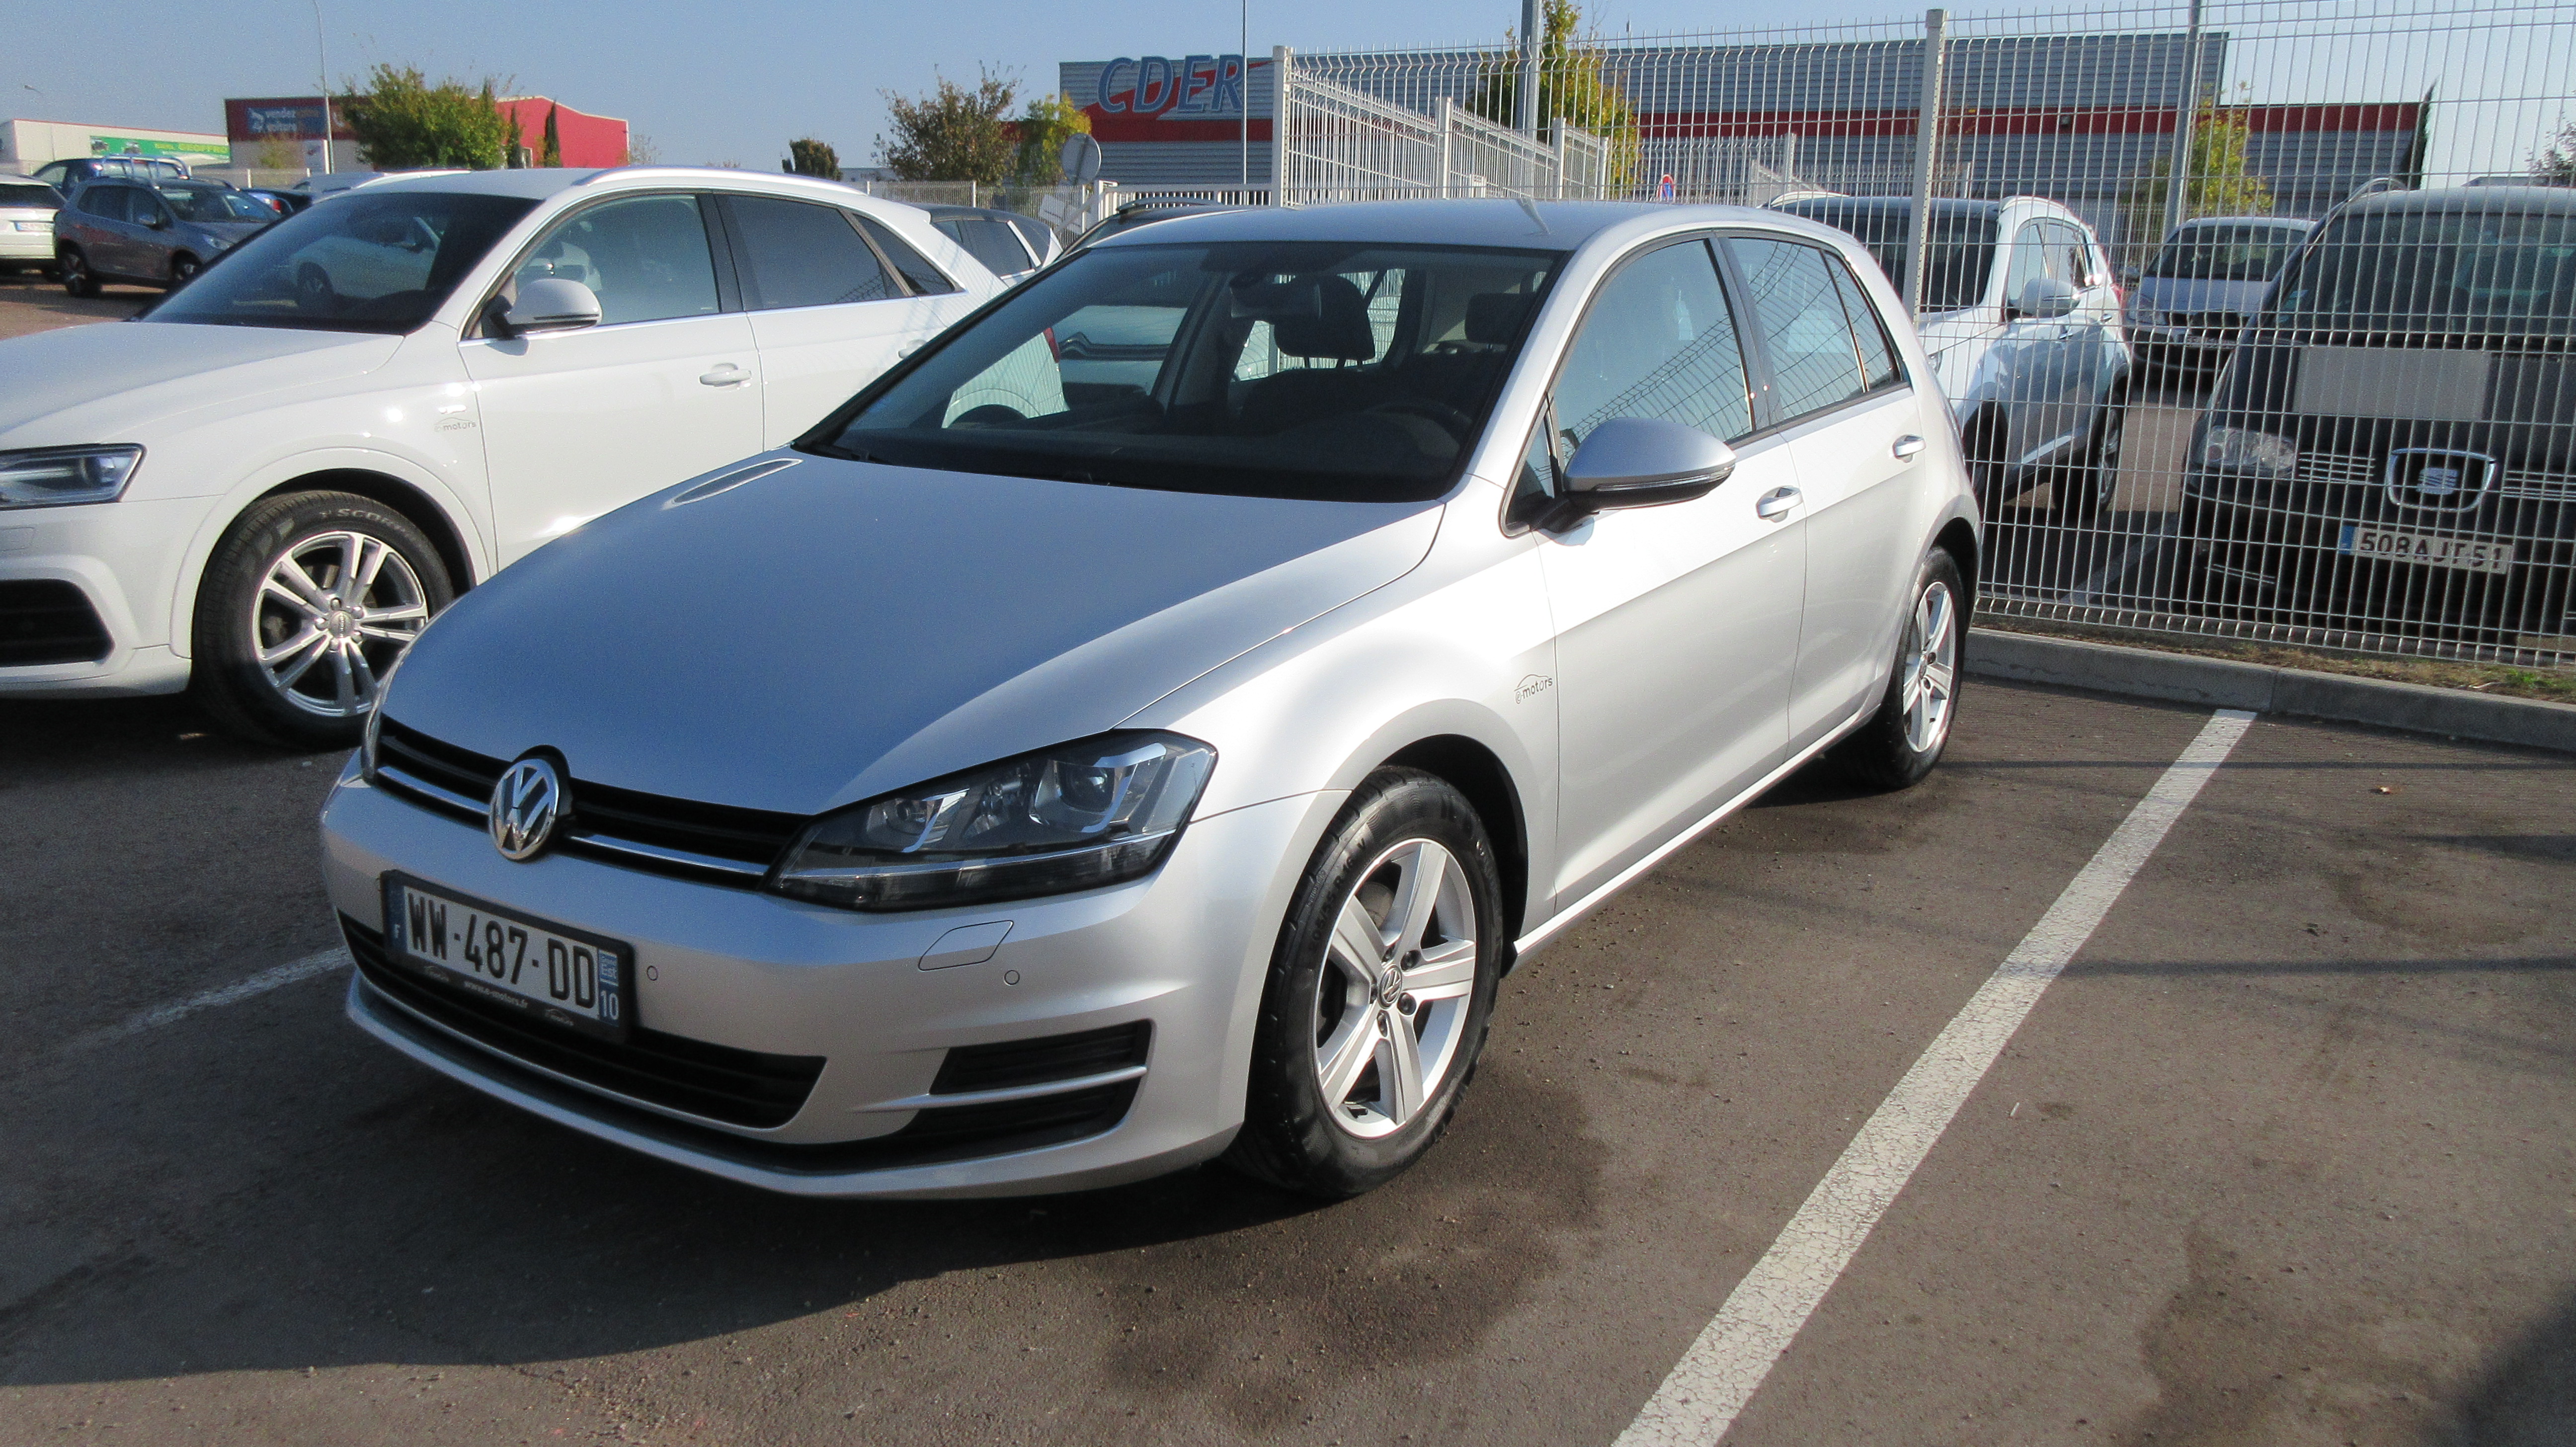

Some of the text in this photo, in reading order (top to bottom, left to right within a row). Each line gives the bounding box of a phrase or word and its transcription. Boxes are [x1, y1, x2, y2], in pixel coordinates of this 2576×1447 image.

[1097, 54, 1243, 113] CDER
[394, 924, 401, 939] F
[600, 990, 619, 1020] 10
